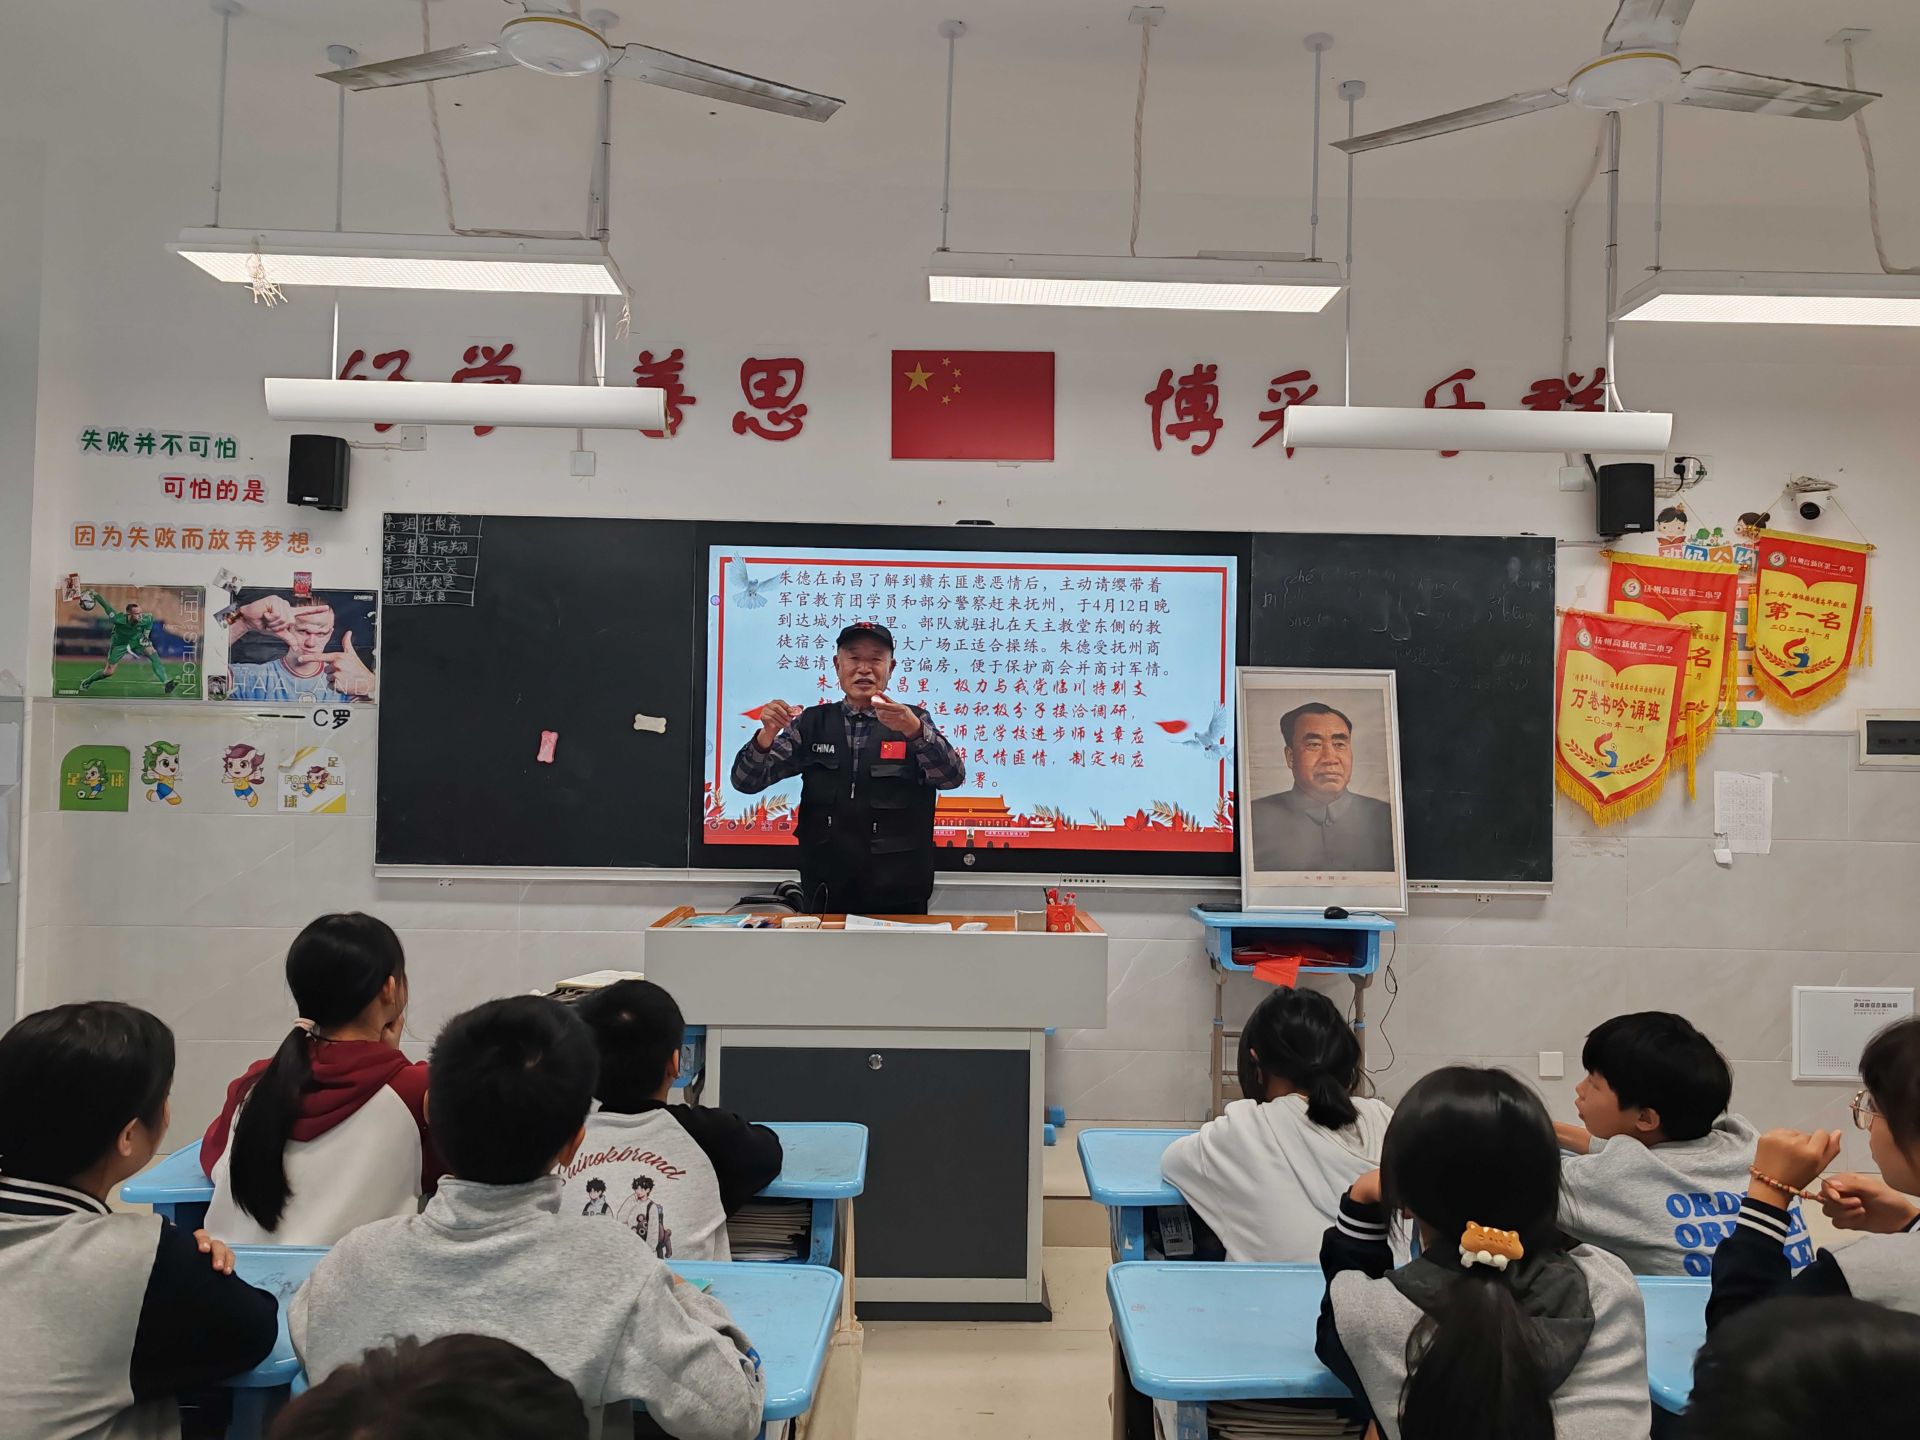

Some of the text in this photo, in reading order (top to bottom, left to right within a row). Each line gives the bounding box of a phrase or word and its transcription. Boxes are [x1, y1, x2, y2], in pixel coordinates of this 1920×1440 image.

[80, 430, 237, 459] 失败并不可怕
[163, 476, 265, 503] 可怕的是
[74, 525, 323, 555] 因为失败而放弃梦想。
[1765, 602, 1841, 630] 第一名
[232, 676, 370, 694] HAALAND
[1570, 688, 1661, 722] 万卷书吟诵班
[811, 743, 835, 754] CHINA
